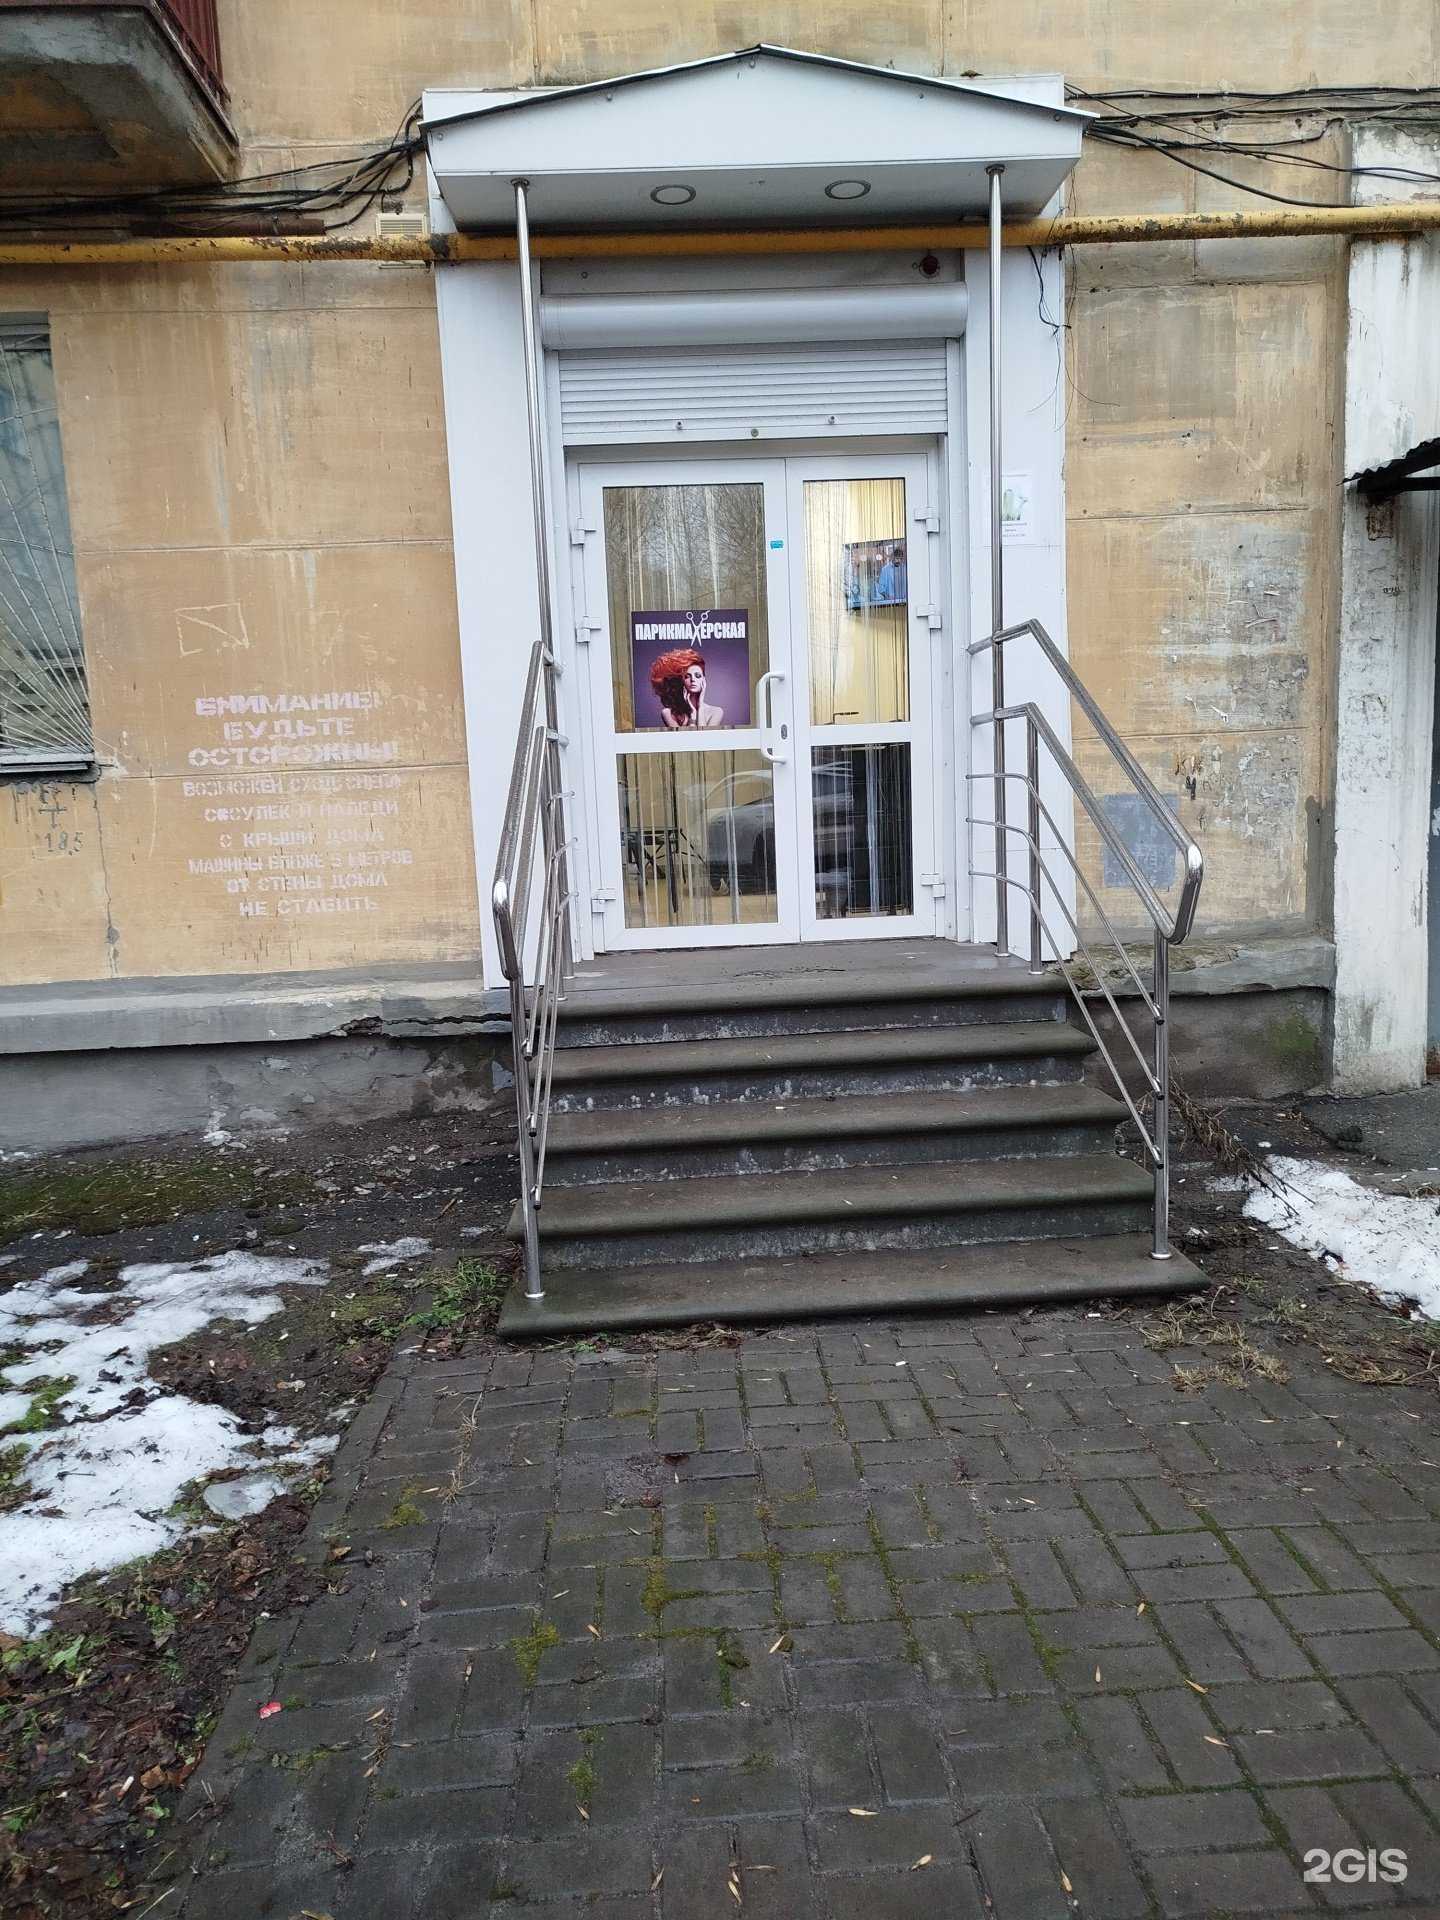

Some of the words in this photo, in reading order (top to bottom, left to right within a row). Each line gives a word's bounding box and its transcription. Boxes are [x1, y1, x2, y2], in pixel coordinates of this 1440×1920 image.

[635, 615, 746, 645] ПАРИКМАХЕРСКАЯ
[223, 716, 354, 740] БУДЬТЕ
[187, 857, 262, 874] МАШИНЫ
[226, 877, 249, 893] ОТ
[258, 874, 322, 892] СТЕНЫ
[331, 872, 388, 889] ДОМА
[239, 900, 267, 917] НЕ
[277, 896, 379, 914] СТАВИТЬ
